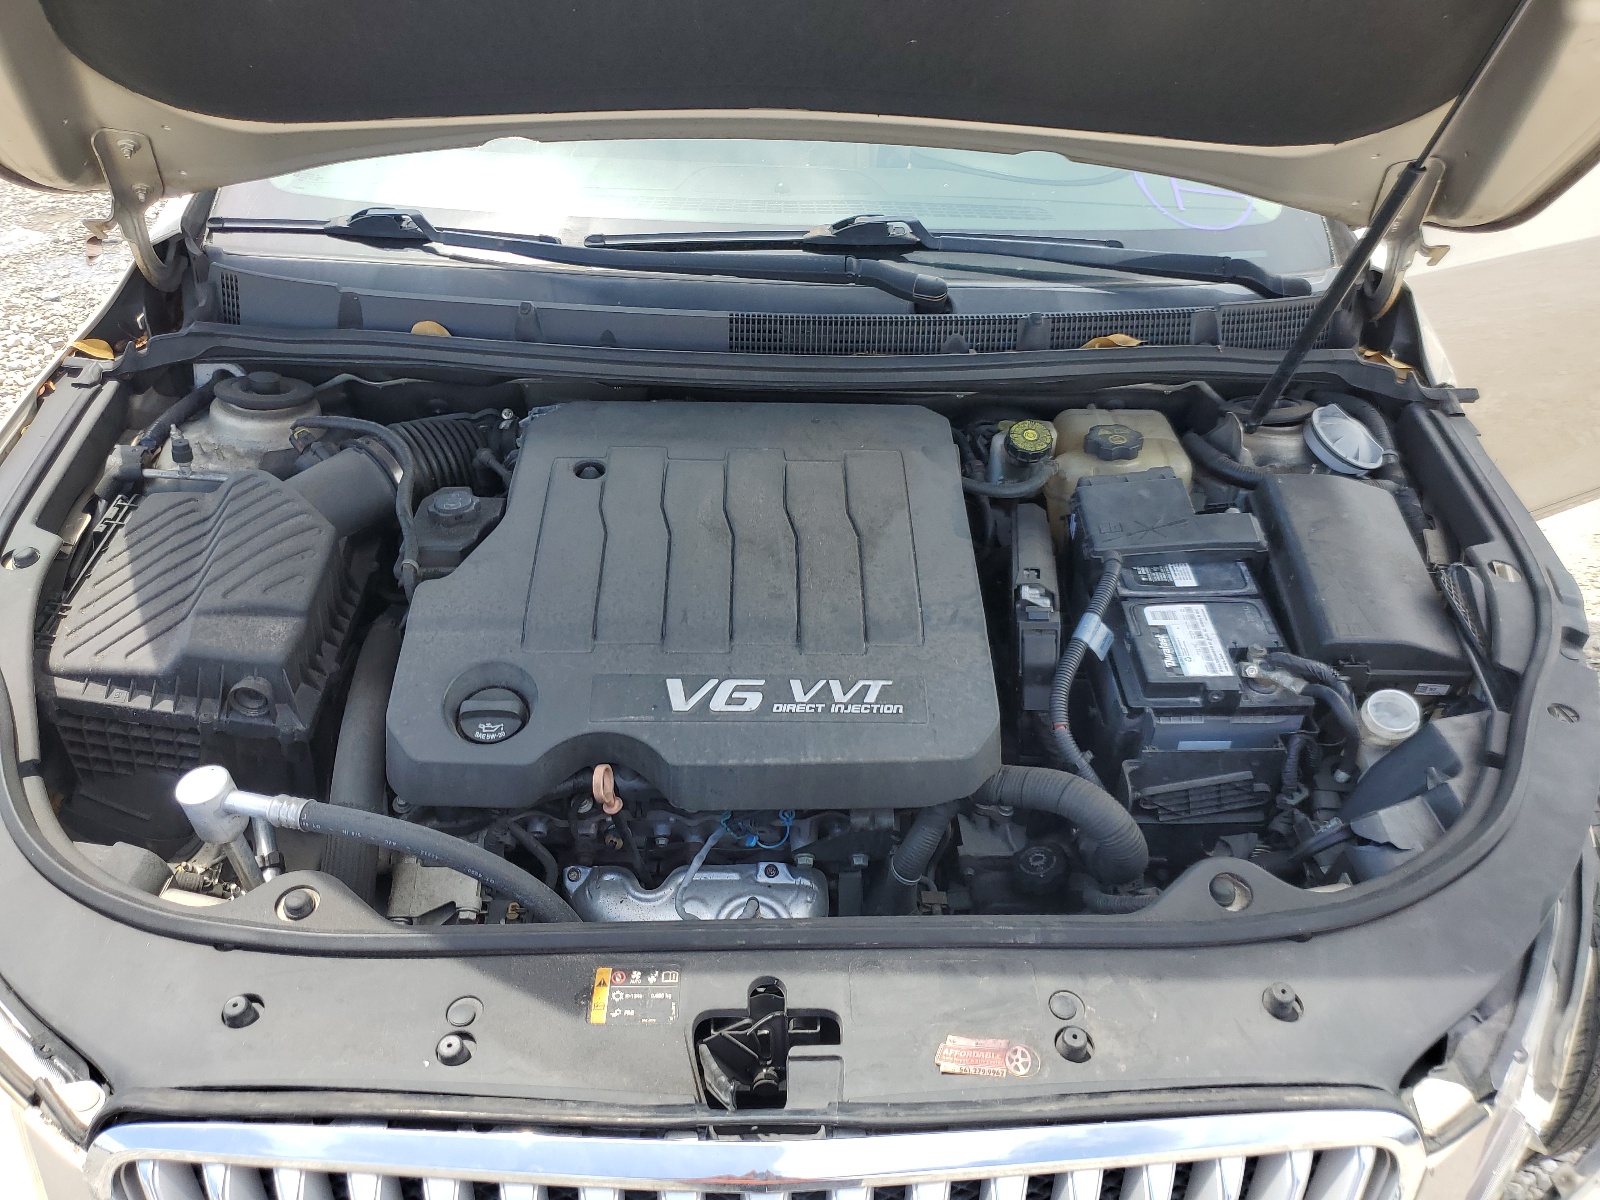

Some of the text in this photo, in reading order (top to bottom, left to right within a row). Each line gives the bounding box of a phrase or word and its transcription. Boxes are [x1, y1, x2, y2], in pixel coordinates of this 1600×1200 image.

[1154, 633, 1179, 668] Duralast
[666, 678, 893, 712] V6 VVT
[772, 703, 903, 714] DIRECT INJECTION
[474, 731, 486, 740] SAE
[942, 1047, 1002, 1060] AFFORDABLE
